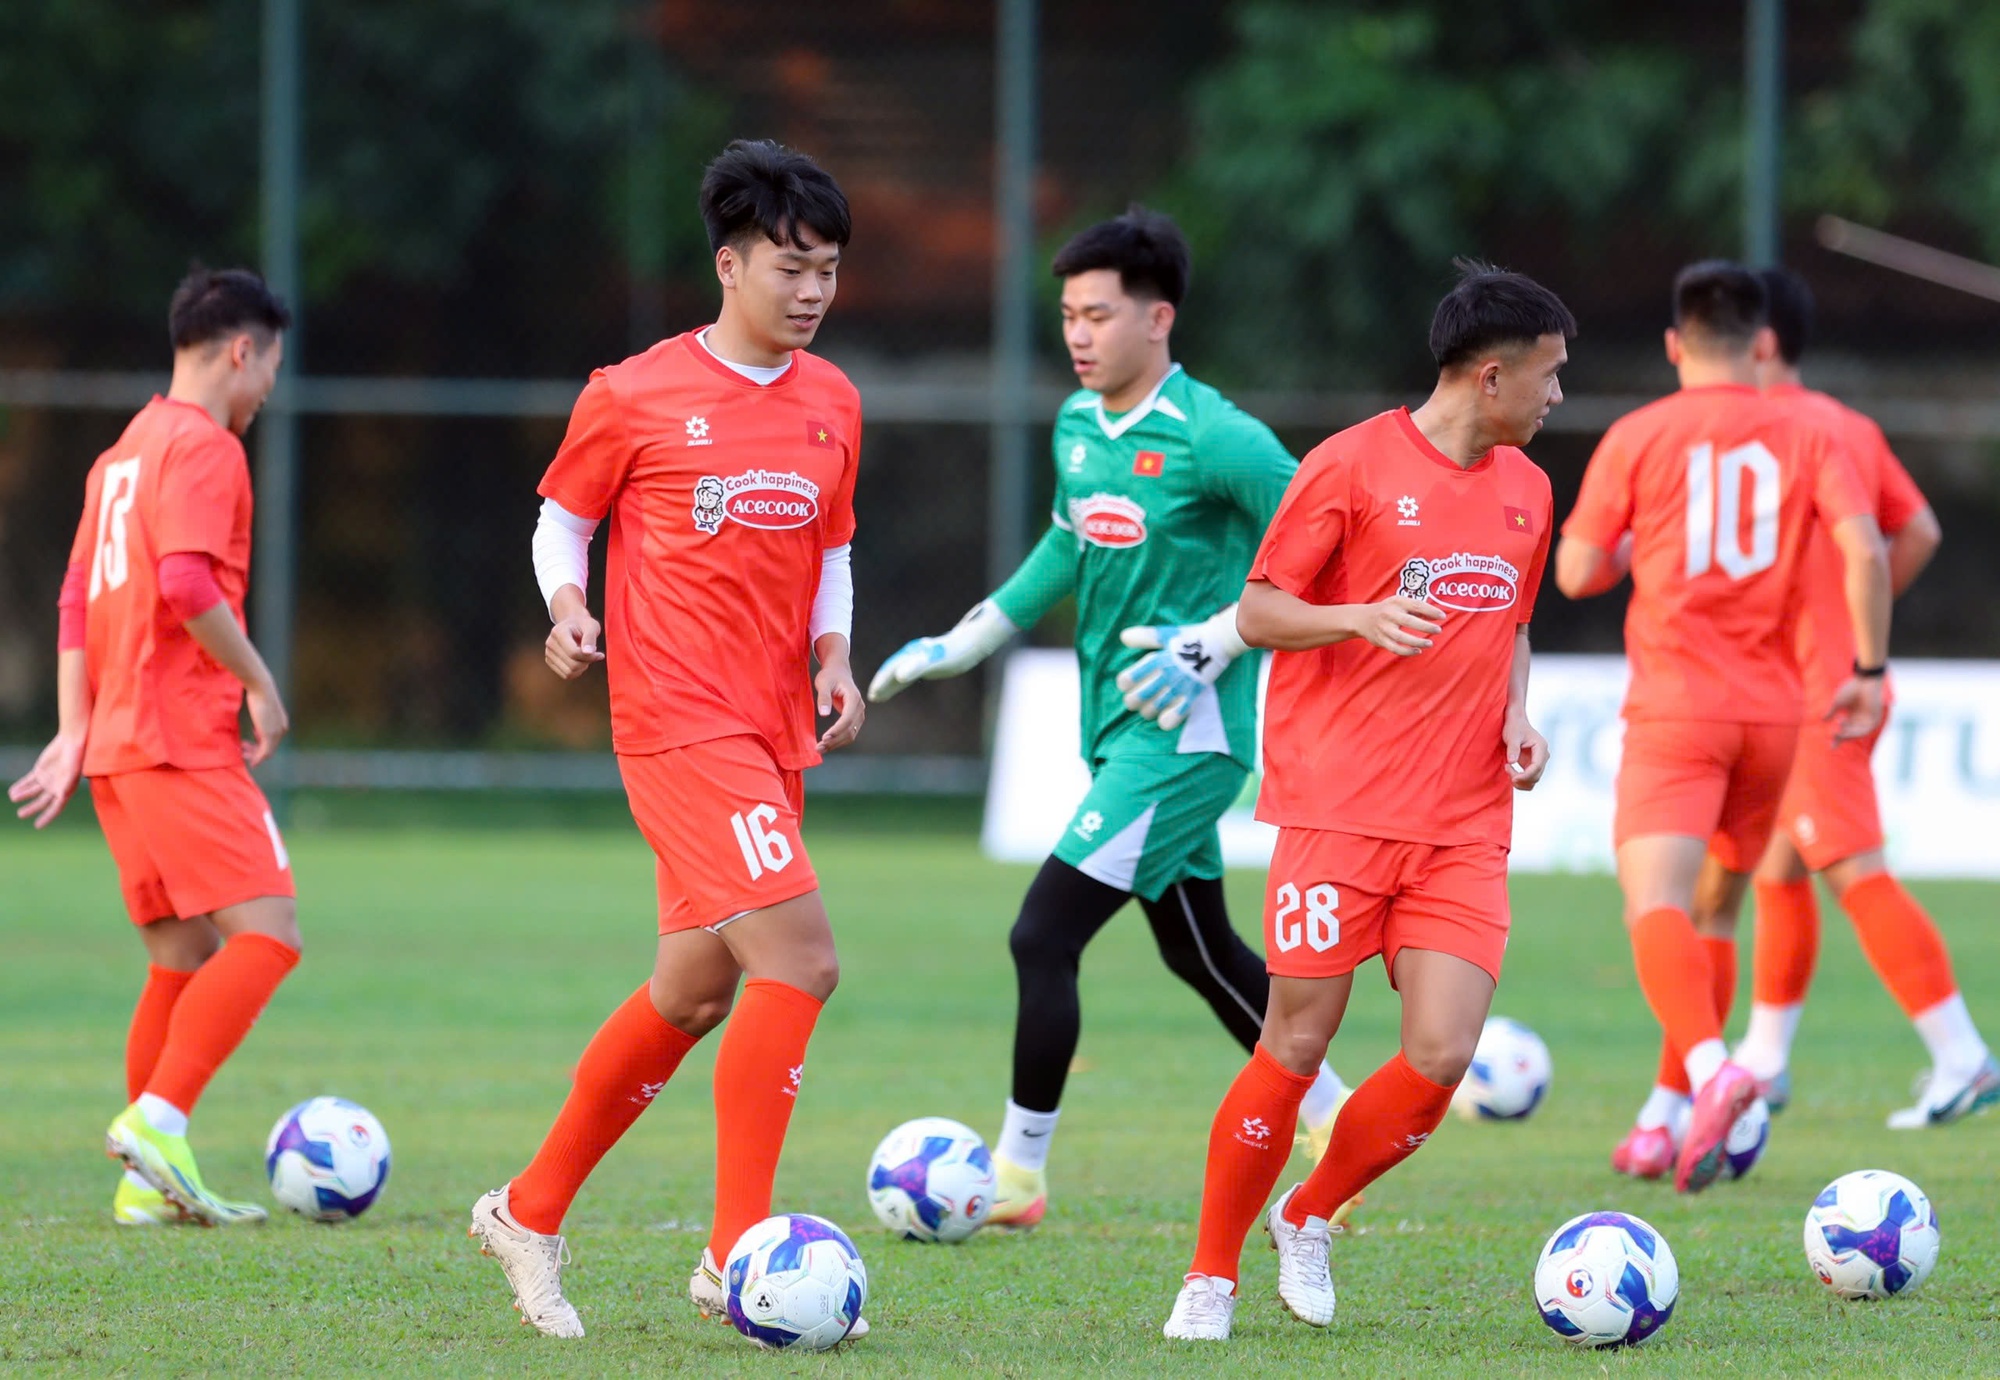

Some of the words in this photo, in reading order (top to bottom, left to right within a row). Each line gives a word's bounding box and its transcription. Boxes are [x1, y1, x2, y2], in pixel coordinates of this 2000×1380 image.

[726, 474, 757, 491] Cook
[761, 473, 818, 497] happiness
[1685, 440, 1781, 582] 10
[88, 456, 141, 602] 13
[1431, 555, 1462, 574] Cook
[1465, 554, 1518, 581] happiness
[730, 802, 794, 881] 16
[1275, 882, 1340, 953] 28
